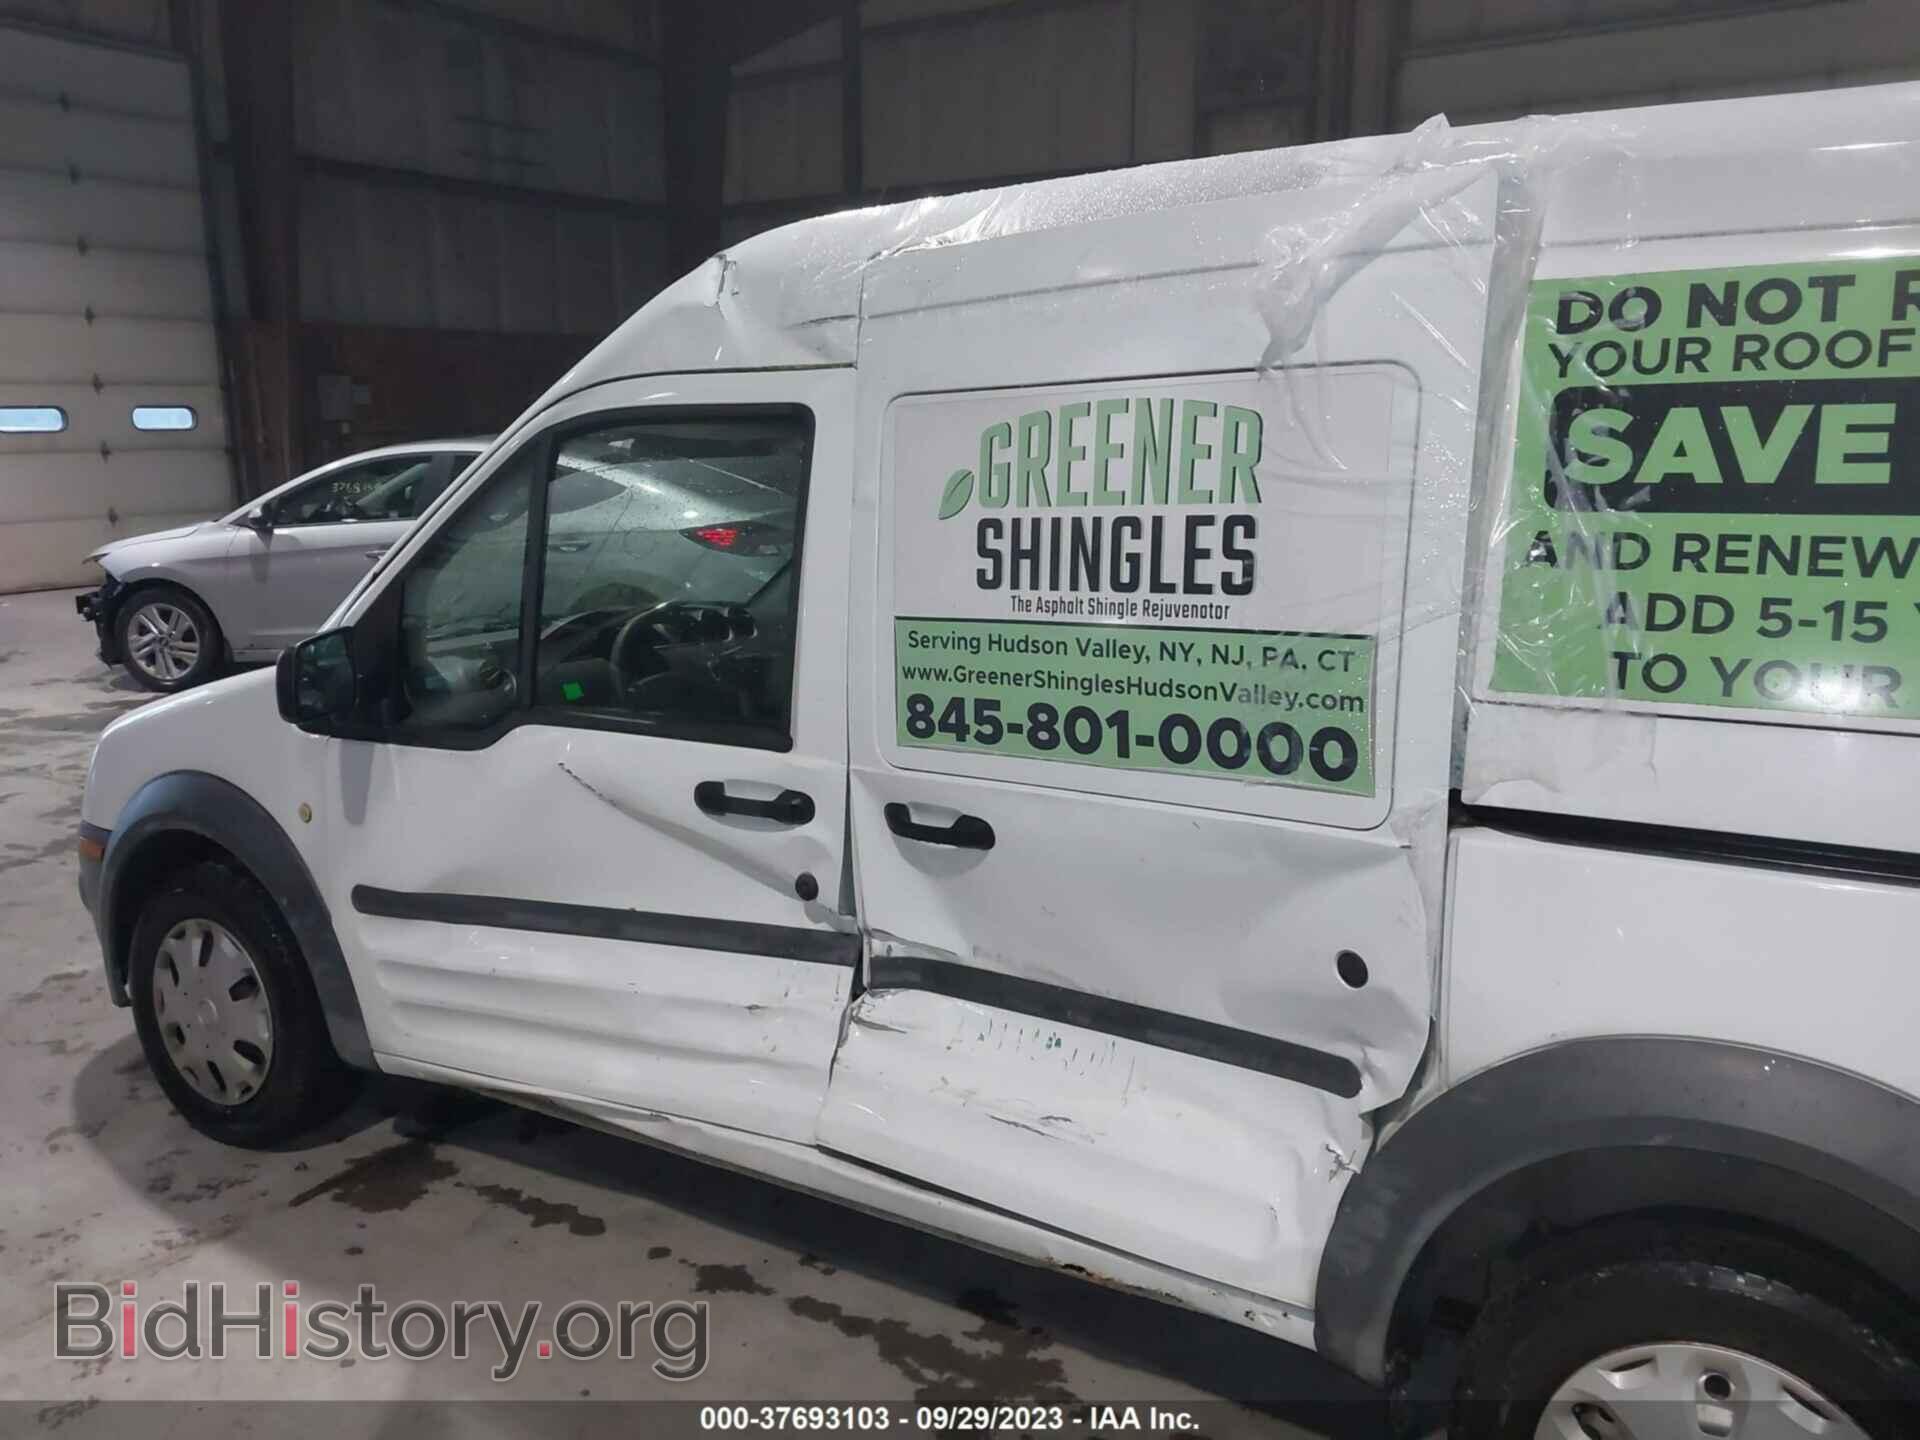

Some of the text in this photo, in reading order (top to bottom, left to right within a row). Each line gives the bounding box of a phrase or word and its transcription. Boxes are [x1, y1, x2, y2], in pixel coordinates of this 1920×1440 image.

[1556, 286, 1662, 335] DO
[1686, 274, 1856, 328] NOT
[1549, 328, 1916, 378] YOUR ROOF
[978, 397, 1263, 508] GREENER
[1564, 403, 1897, 485] SAVE
[976, 514, 1257, 596] SHINGLES
[1520, 530, 1920, 579] AND RENEW
[1011, 595, 1230, 621] The Asphalt Shingle Rejuvenator
[1598, 591, 1888, 643] ADD 5-15
[908, 630, 981, 654] Serving
[988, 633, 1069, 656] Hudson
[1075, 637, 1151, 665] Valley,
[1159, 641, 1203, 667] NY,
[1211, 644, 1253, 670] NJ,
[1317, 649, 1356, 673] CT
[1612, 651, 1688, 693] TO
[902, 665, 1365, 713] www.GreenerShinglesHudsonValley.com
[906, 693, 1359, 782] 845-801-0000
